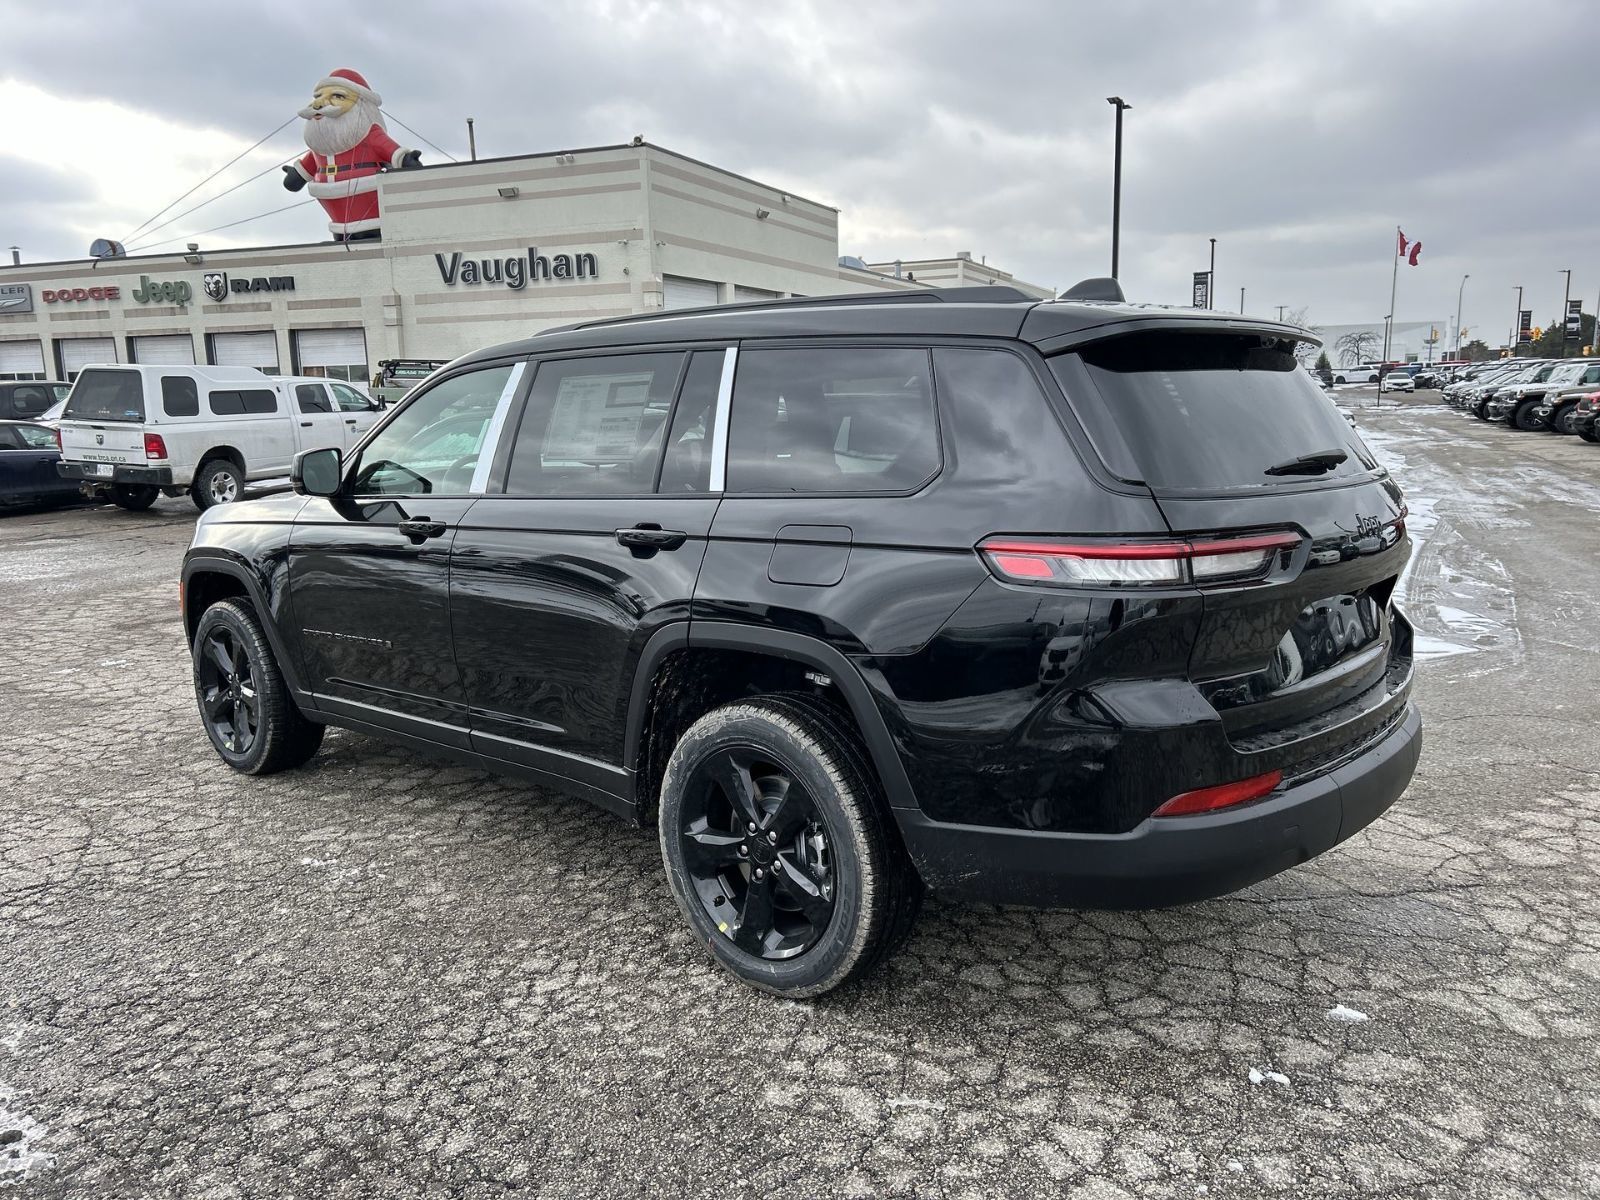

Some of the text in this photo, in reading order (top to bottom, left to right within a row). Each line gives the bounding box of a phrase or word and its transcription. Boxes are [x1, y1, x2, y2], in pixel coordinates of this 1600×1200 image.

[434, 246, 598, 290] Vaughan
[42, 286, 121, 303] DODGE
[132, 275, 192, 307] Jeep
[230, 276, 296, 294] RAM
